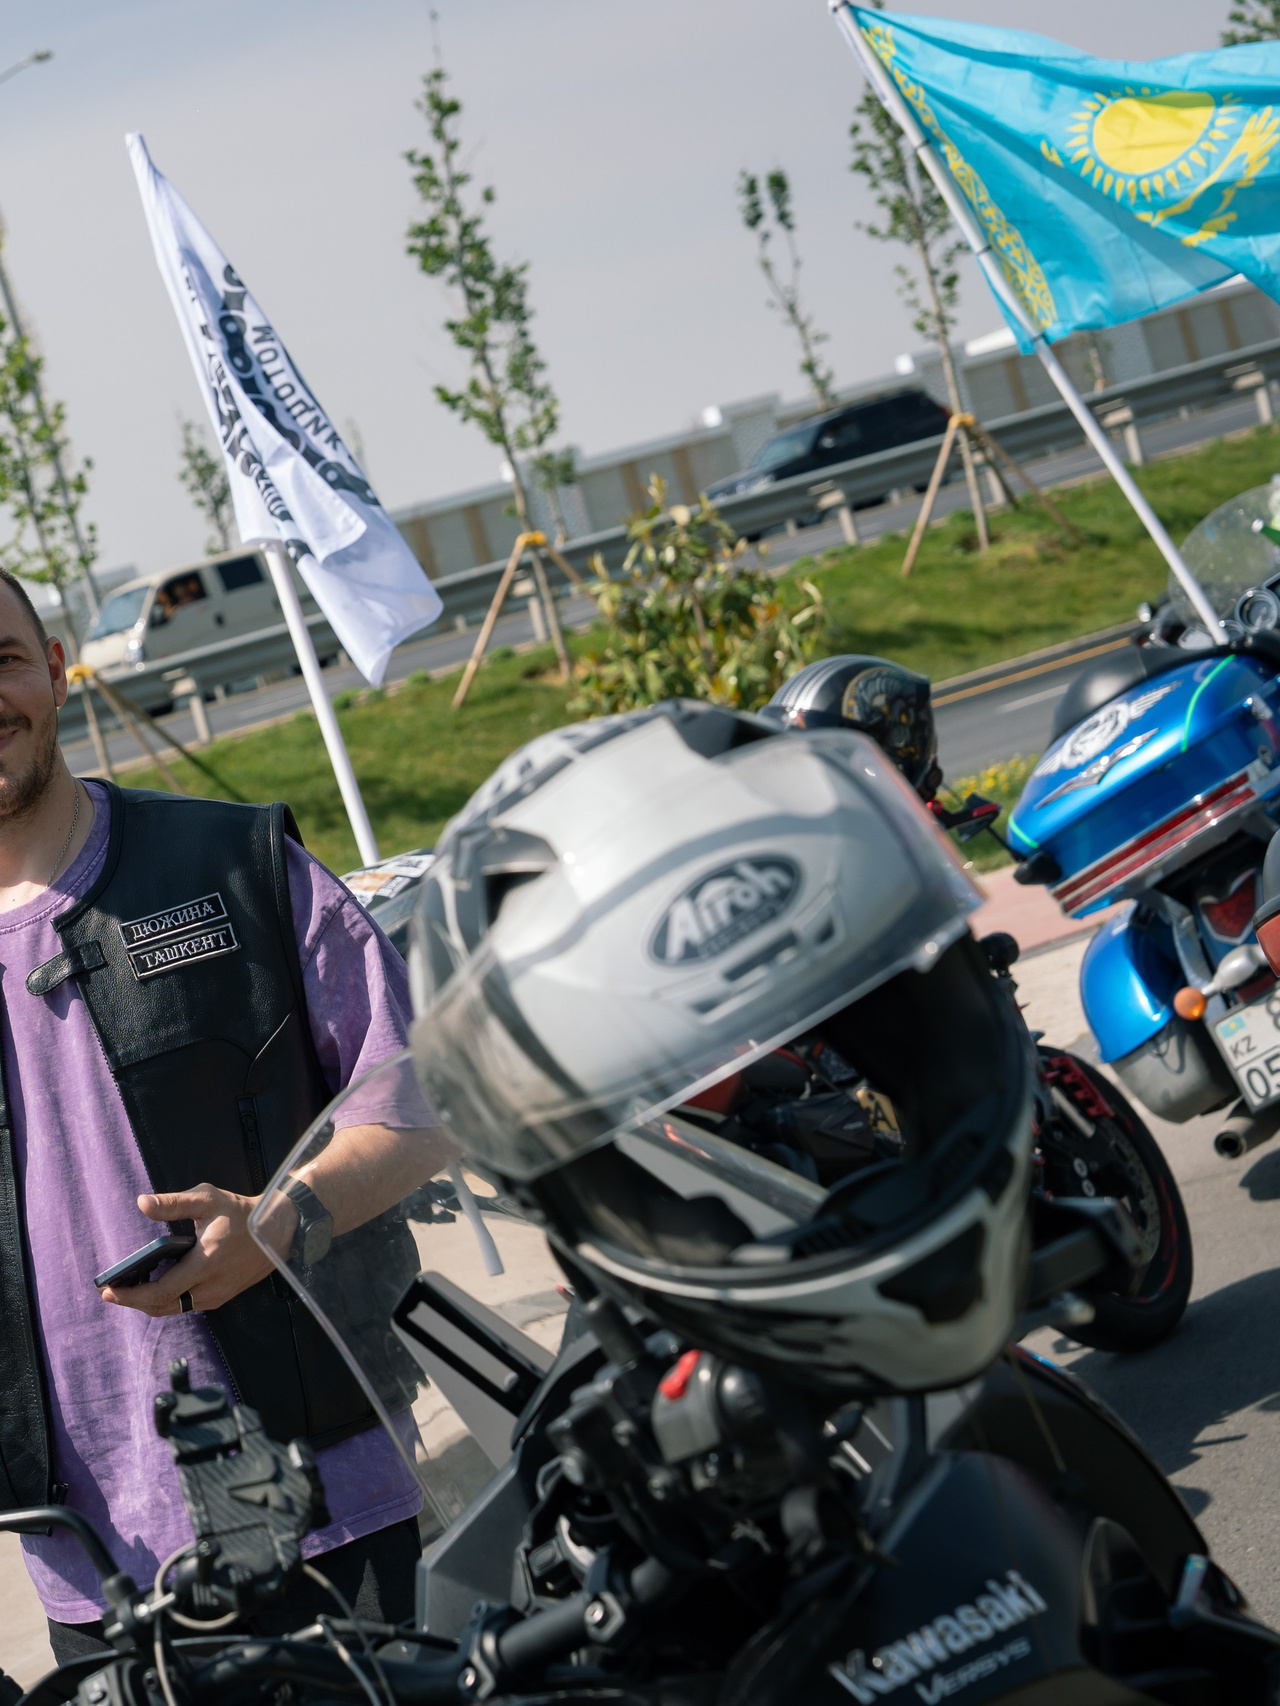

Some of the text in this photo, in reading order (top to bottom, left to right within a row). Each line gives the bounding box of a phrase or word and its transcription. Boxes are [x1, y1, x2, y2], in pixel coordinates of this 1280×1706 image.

[132, 901, 216, 941] ДЮЖИНА
[664, 860, 792, 962] Airoh
[140, 930, 228, 969] ТАШКЕНТ
[1229, 1034, 1257, 1060] KZ
[827, 1569, 1048, 1705] Kawasaki
